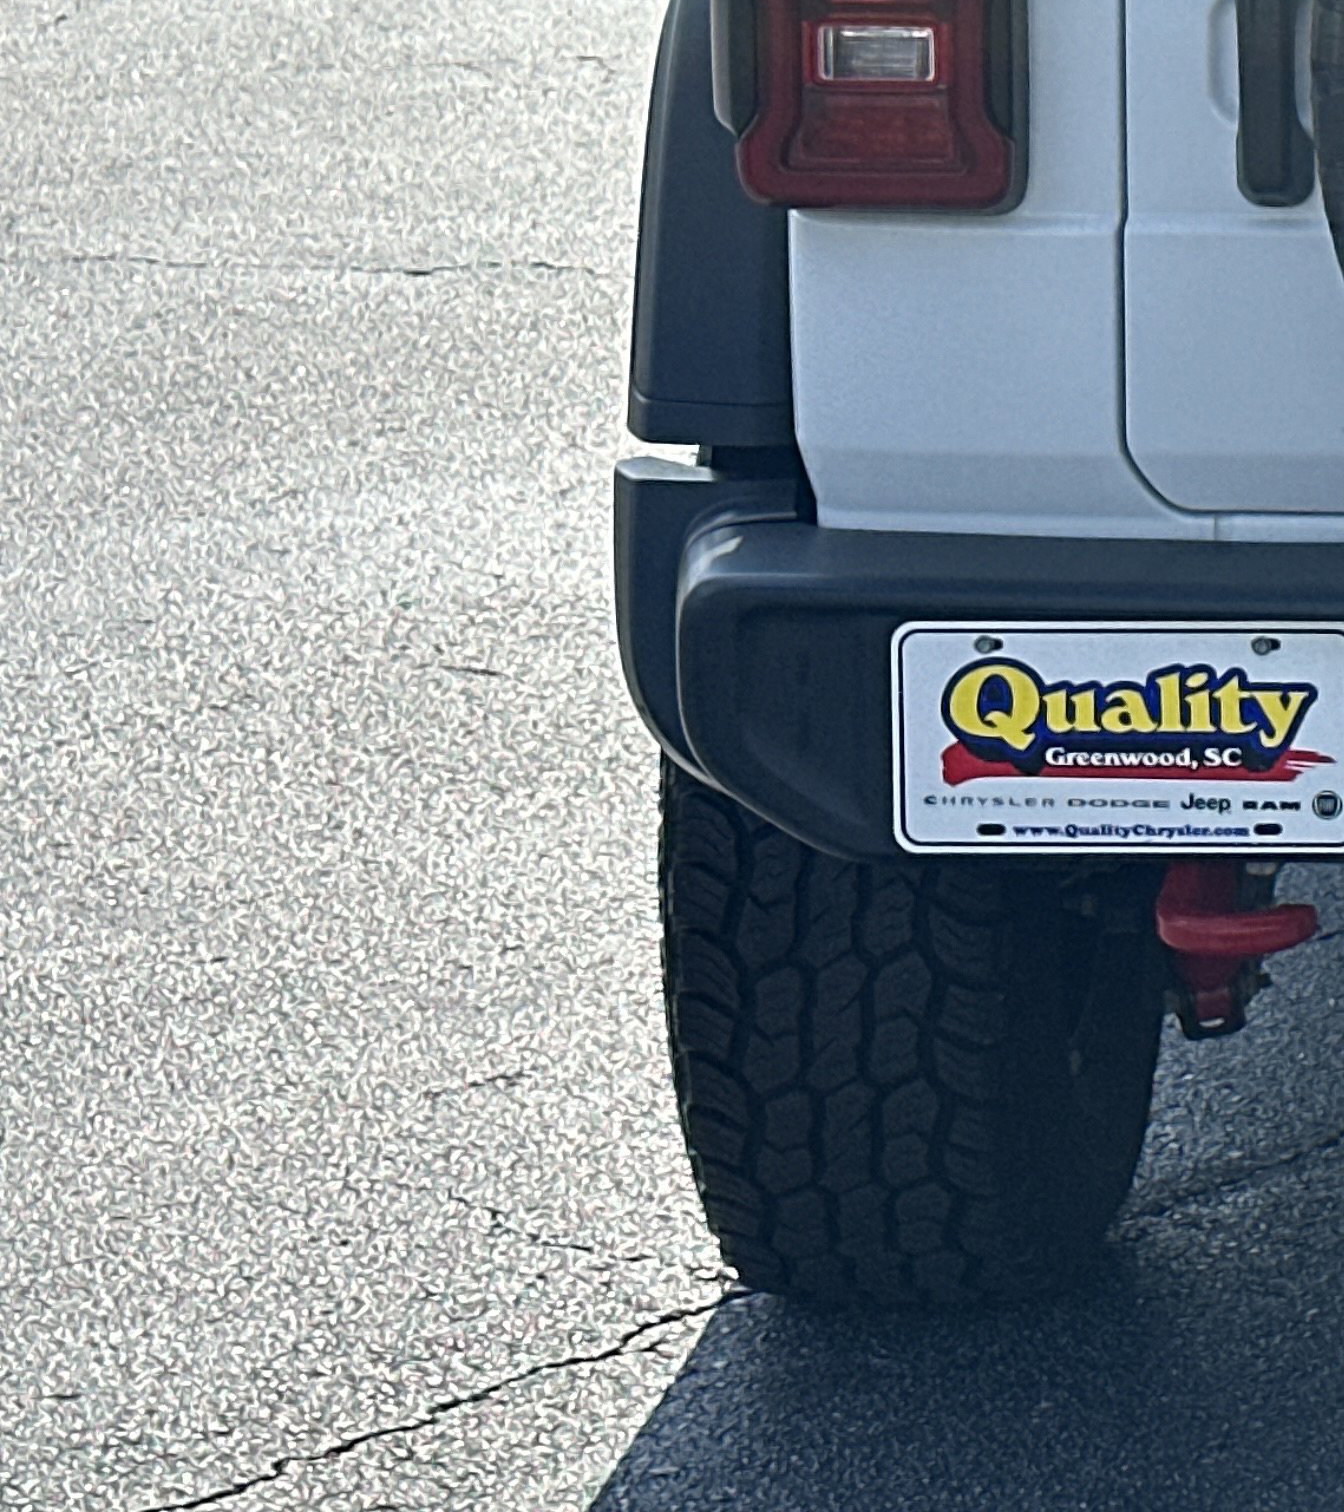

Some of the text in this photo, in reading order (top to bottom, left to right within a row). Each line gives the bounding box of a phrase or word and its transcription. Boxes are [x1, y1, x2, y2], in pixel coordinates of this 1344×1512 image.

[946, 659, 1313, 756] Quality
[1044, 746, 1243, 770] Greenwood, SC
[923, 794, 1056, 808] CHRYSLER
[1067, 797, 1171, 808] DODGE
[1180, 792, 1232, 815] Jeep
[1242, 799, 1302, 811] RAM
[1012, 823, 1250, 838] www.QualityChrysler.com
